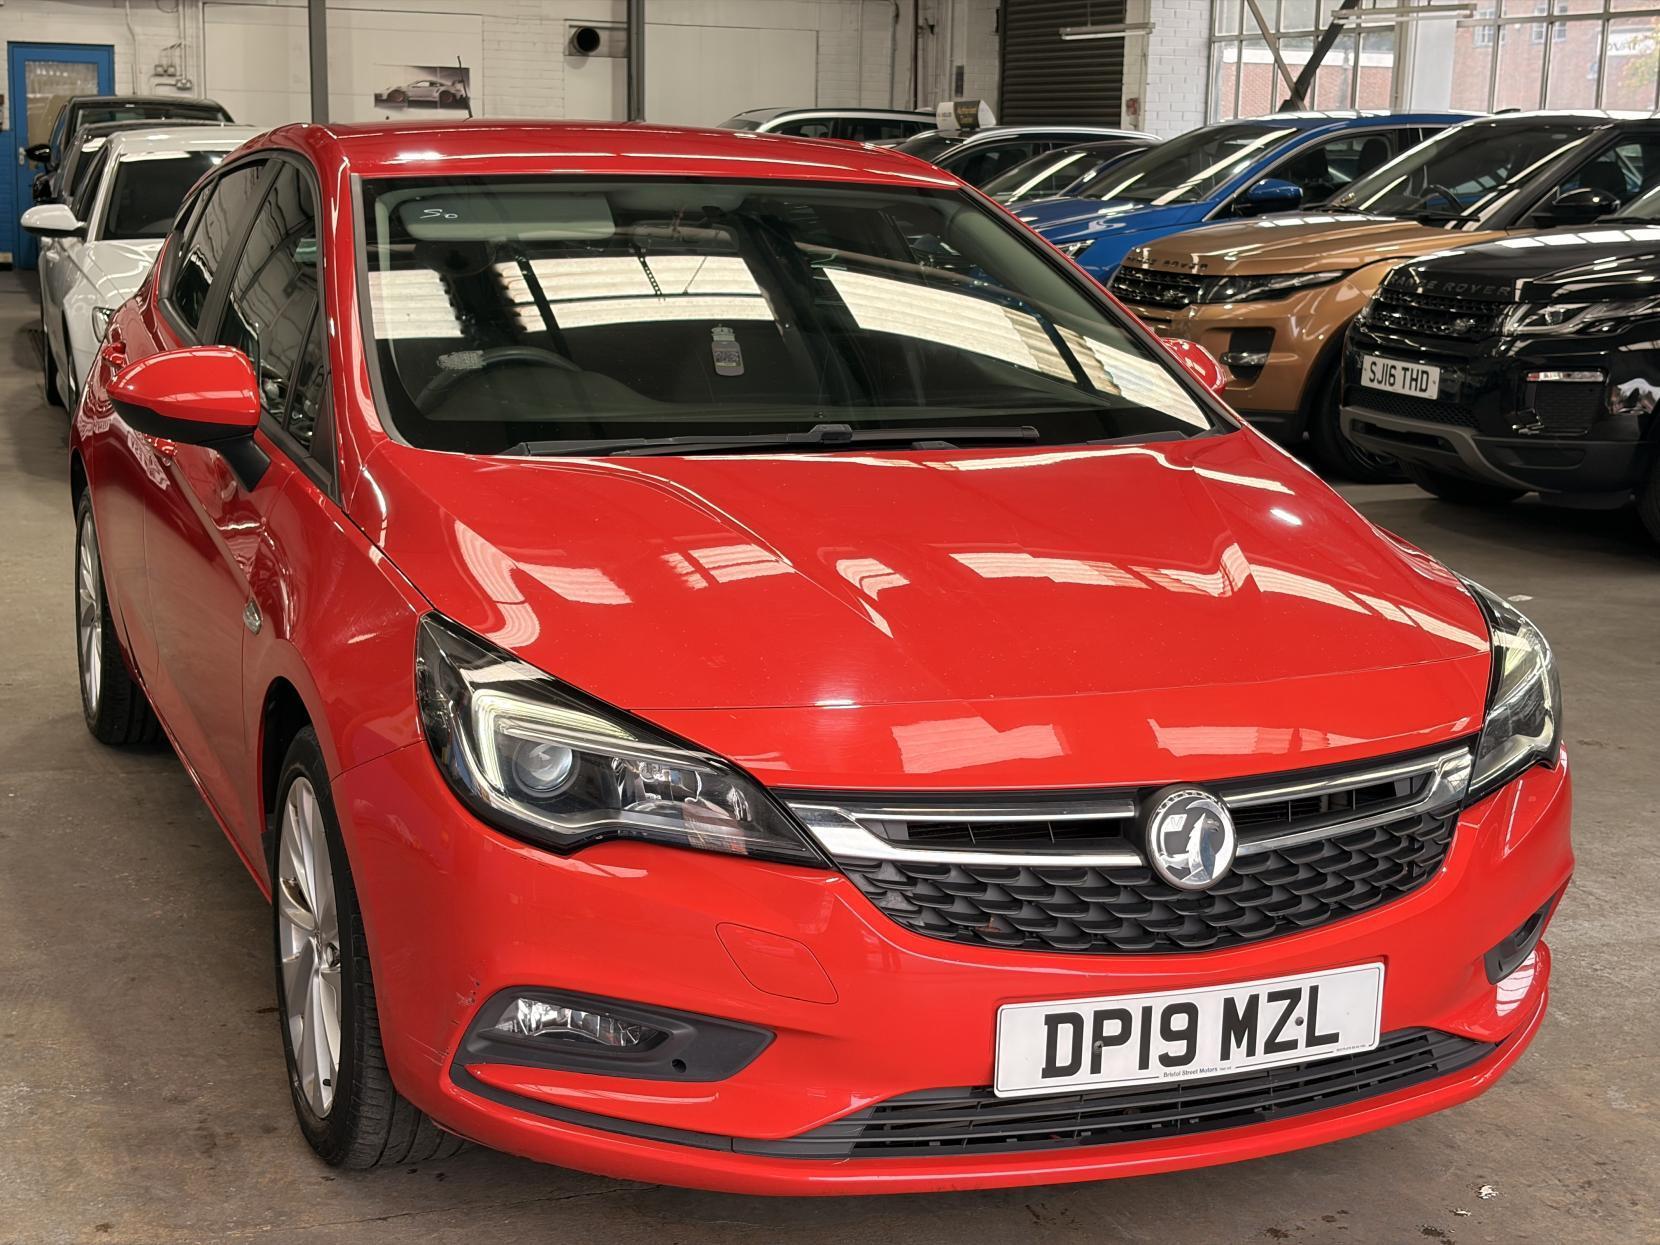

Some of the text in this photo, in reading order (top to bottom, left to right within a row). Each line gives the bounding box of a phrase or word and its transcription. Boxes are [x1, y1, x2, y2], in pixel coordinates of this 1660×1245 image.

[1391, 274, 1513, 297] RANE ROVER
[1369, 361, 1429, 393] SJ16 THD
[1041, 985, 1340, 1079] DP19 MZL
[1163, 1070, 1181, 1078] Bristol
[1181, 1068, 1199, 1076] Street
[1199, 1066, 1218, 1074] Motors
